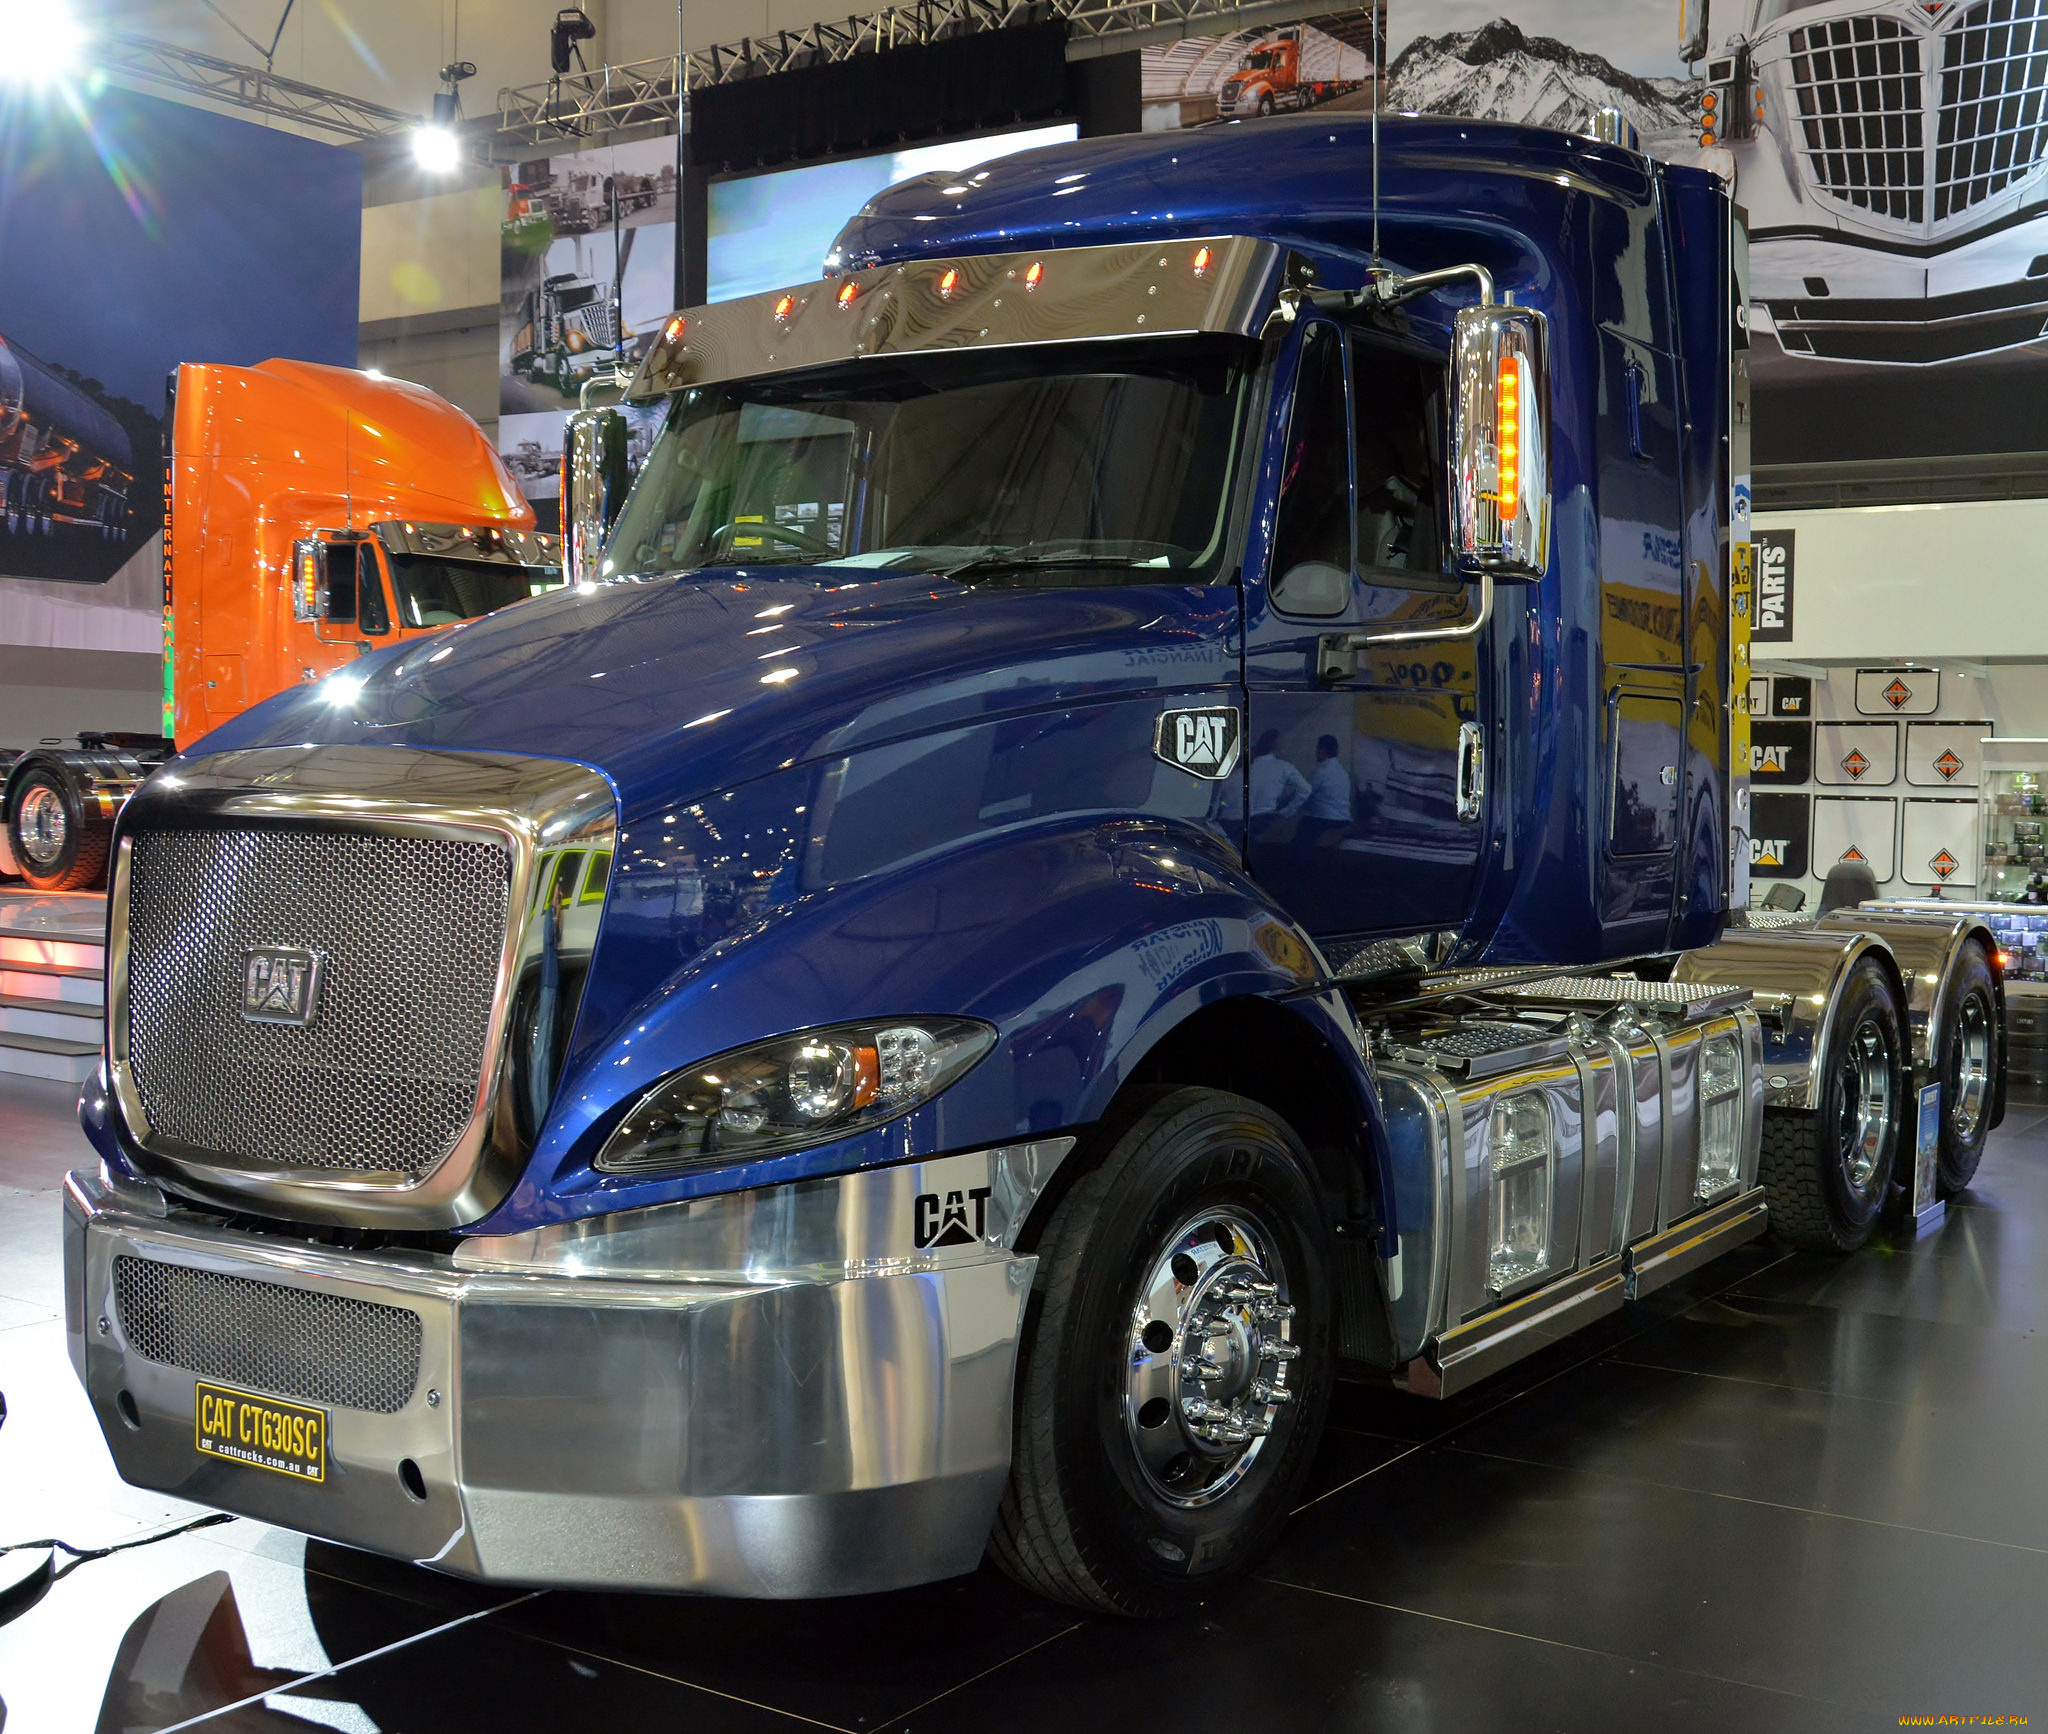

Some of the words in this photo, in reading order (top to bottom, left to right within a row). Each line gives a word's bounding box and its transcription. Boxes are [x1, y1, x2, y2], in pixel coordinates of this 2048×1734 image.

[163, 468, 173, 662] INTERNATIONAL
[1761, 546, 1786, 628] PARTS
[1782, 697, 1802, 710] CAT
[1176, 714, 1226, 763] CAT
[1750, 745, 1789, 772] CAT
[1749, 838, 1787, 865] CAT
[246, 955, 308, 1013] CAT
[914, 1187, 992, 1248] CAT
[202, 1394, 236, 1438] CAT
[239, 1403, 318, 1460] CT630SC
[201, 1438, 213, 1450] CAT
[218, 1443, 301, 1472] cattrucks.com.au
[306, 1465, 319, 1478] CAT
